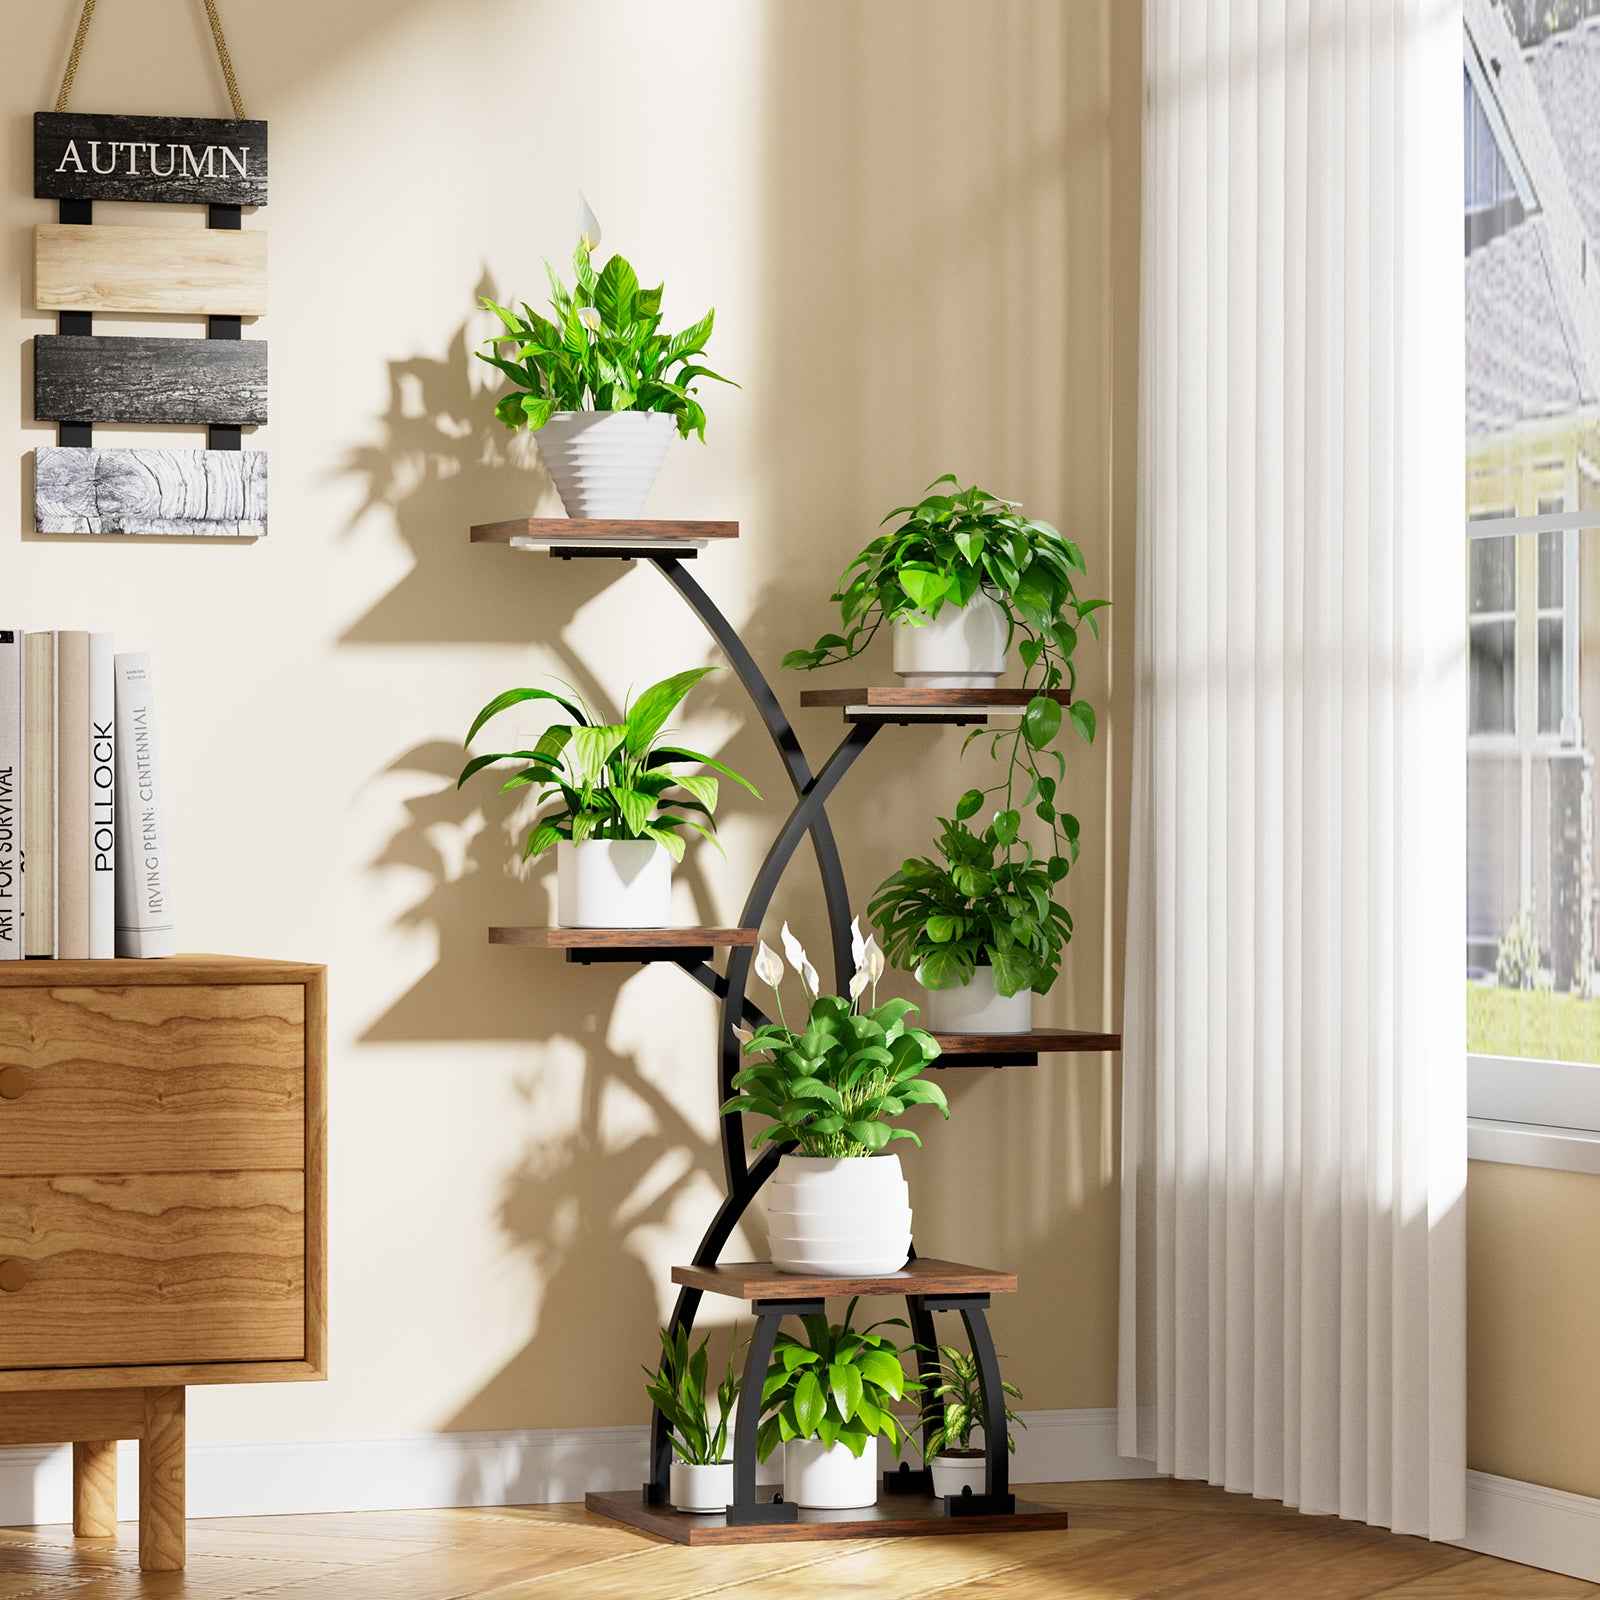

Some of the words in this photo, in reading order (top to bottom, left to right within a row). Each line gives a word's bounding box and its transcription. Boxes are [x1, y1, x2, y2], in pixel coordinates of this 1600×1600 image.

[55, 139, 250, 179] AUTUMN
[132, 706, 153, 802] CENTENNIAL
[94, 722, 113, 872] POLLOCK
[142, 807, 158, 851] PENN:
[145, 857, 163, 914] IRVING
